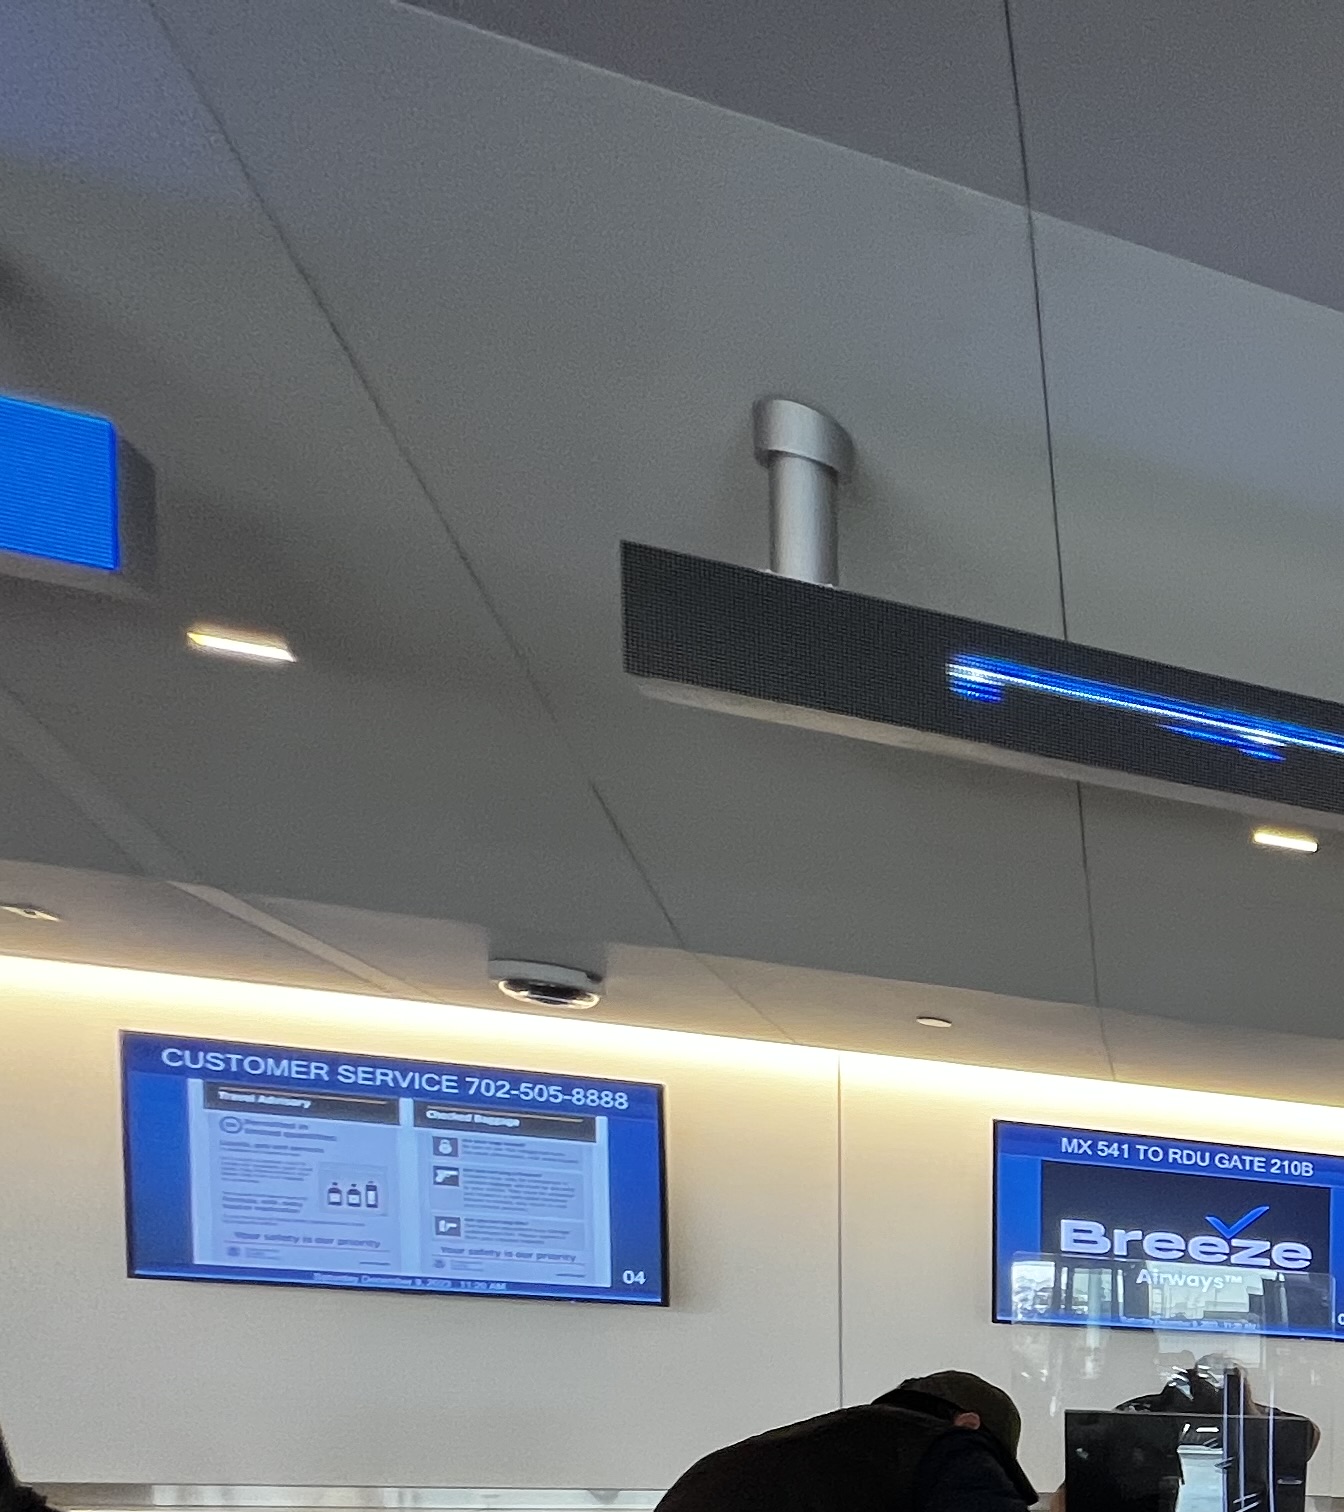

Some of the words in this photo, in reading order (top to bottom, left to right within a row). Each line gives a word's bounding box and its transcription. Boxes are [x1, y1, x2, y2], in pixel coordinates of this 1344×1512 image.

[161, 1048, 330, 1081] CUSTOMER
[337, 1065, 459, 1094] SERVICE
[465, 1077, 629, 1110] 702-505-8888
[1061, 1137, 1093, 1155] MX
[1097, 1141, 1129, 1159] 541
[1136, 1145, 1163, 1162] TO
[1168, 1148, 1210, 1167] RDU
[1215, 1153, 1267, 1172] GATE
[1270, 1159, 1313, 1177] 210B
[1060, 1219, 1313, 1269] Breeze
[622, 1270, 646, 1285] 04
